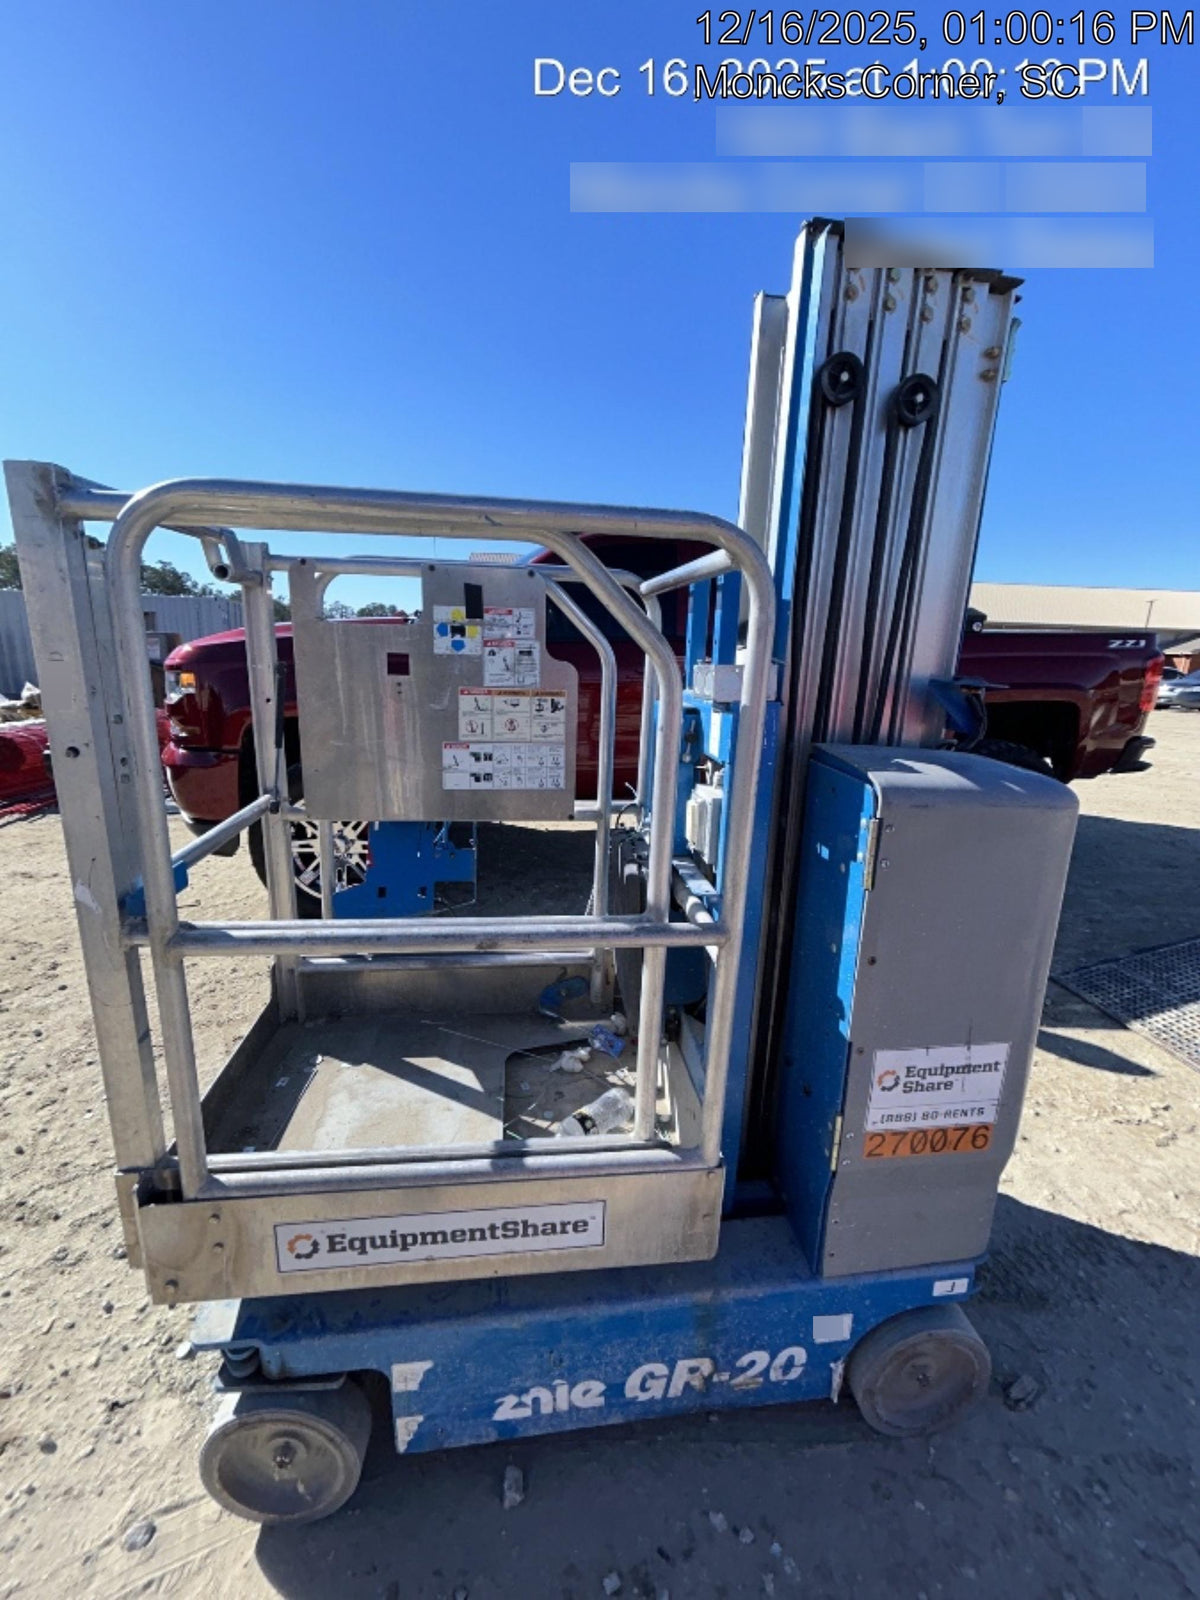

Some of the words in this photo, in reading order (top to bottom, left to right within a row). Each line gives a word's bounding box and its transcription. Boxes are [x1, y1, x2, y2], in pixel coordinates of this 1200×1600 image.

[904, 1061, 1002, 1080] Equipment
[902, 1080, 955, 1094] Share
[865, 1125, 991, 1158] 270076
[325, 1217, 590, 1256] EquipmentShare
